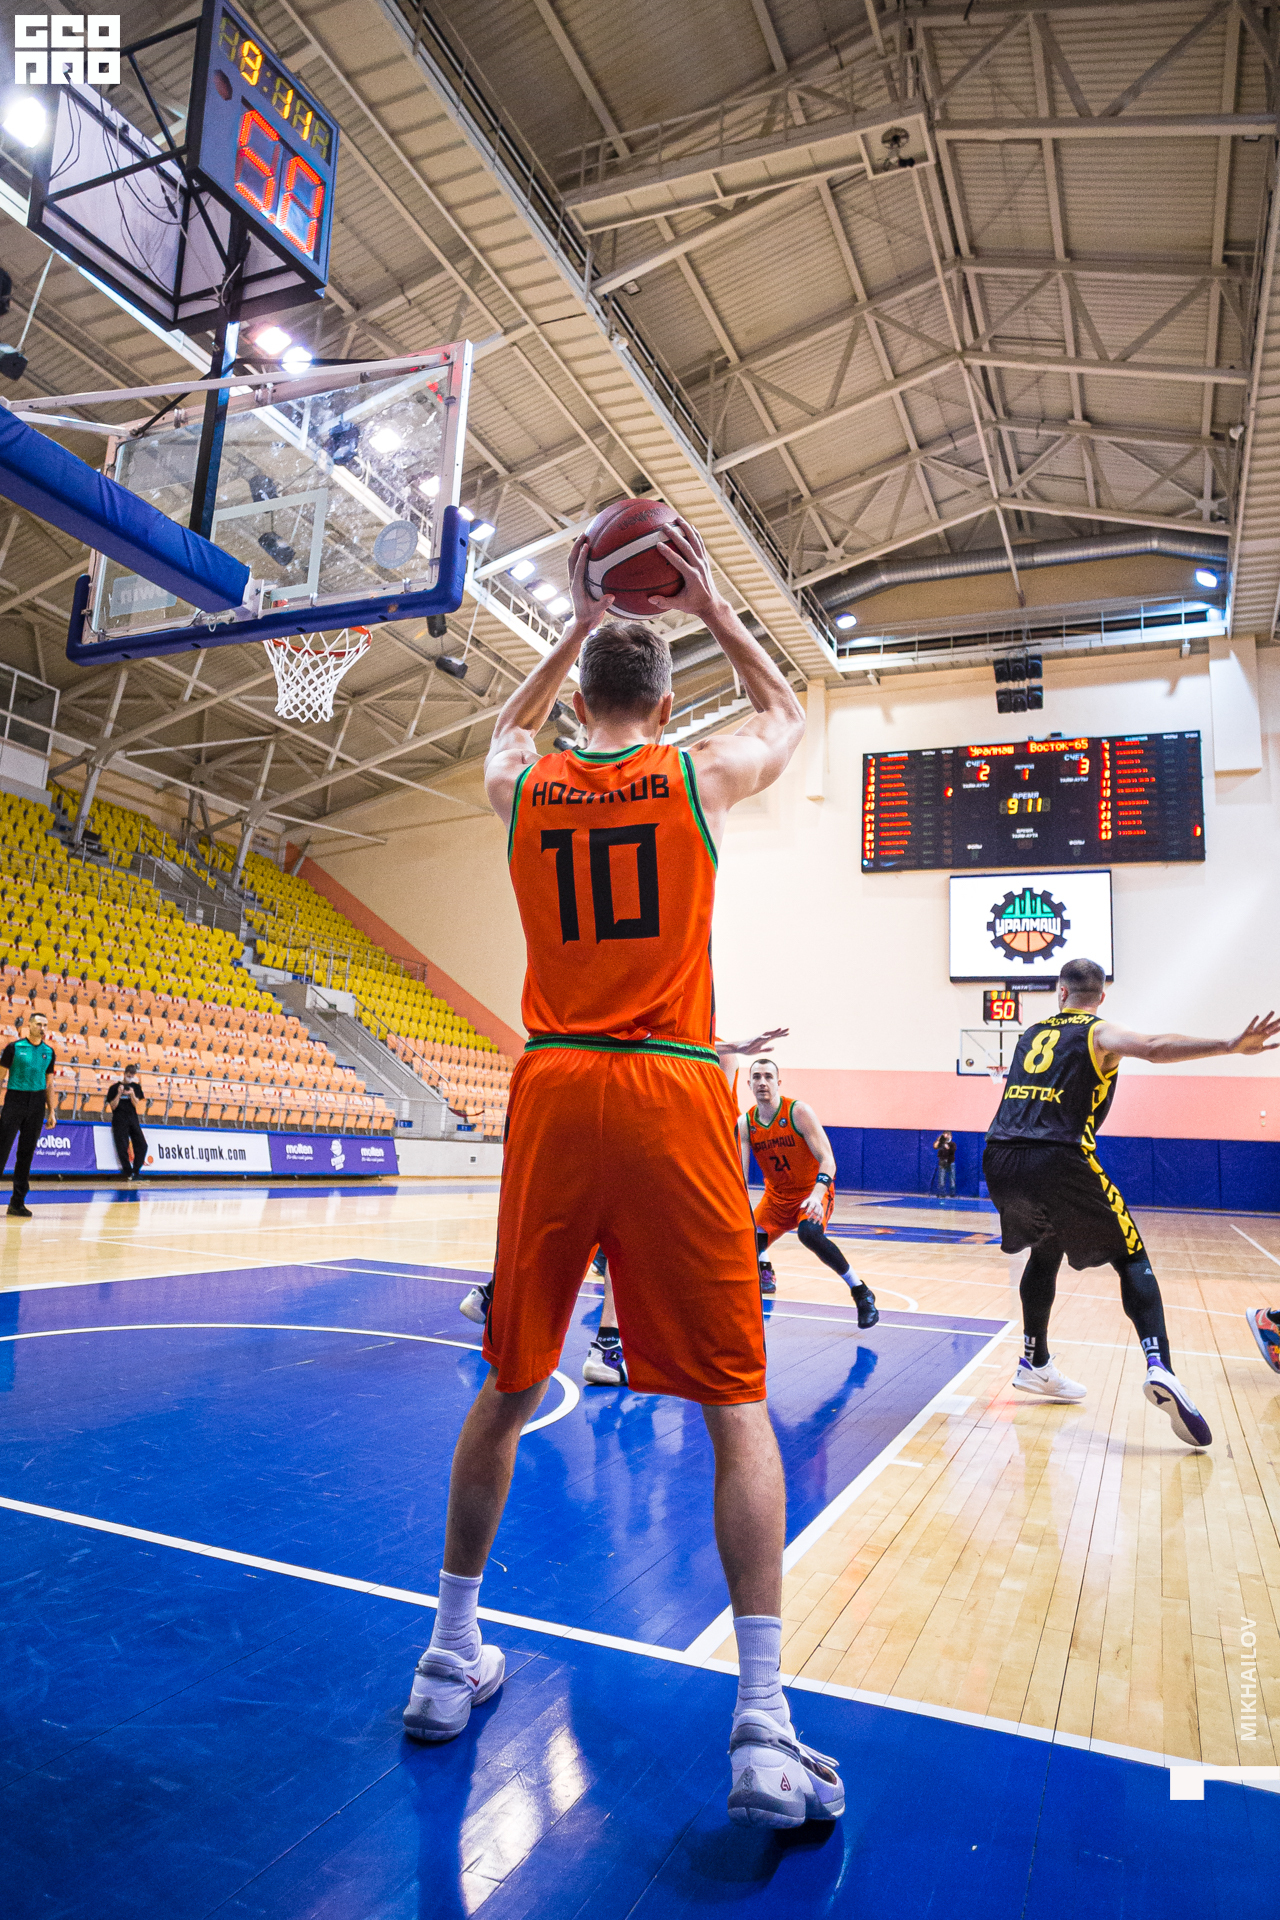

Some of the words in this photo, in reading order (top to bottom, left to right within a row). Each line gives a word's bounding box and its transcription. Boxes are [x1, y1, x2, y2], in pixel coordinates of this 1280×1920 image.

[967, 745, 1015, 757] Уралмаш
[1026, 738, 1089, 754] Восток-65
[977, 763, 990, 782] 2
[1078, 757, 1090, 775] 3
[1012, 791, 1040, 800] ВРЕМЯ
[541, 823, 660, 945] 10
[995, 917, 1061, 937] УРАЛМАШ
[1023, 1029, 1060, 1074] 8
[158, 1143, 247, 1162] basket.ugmk.com
[285, 1143, 314, 1155] molten
